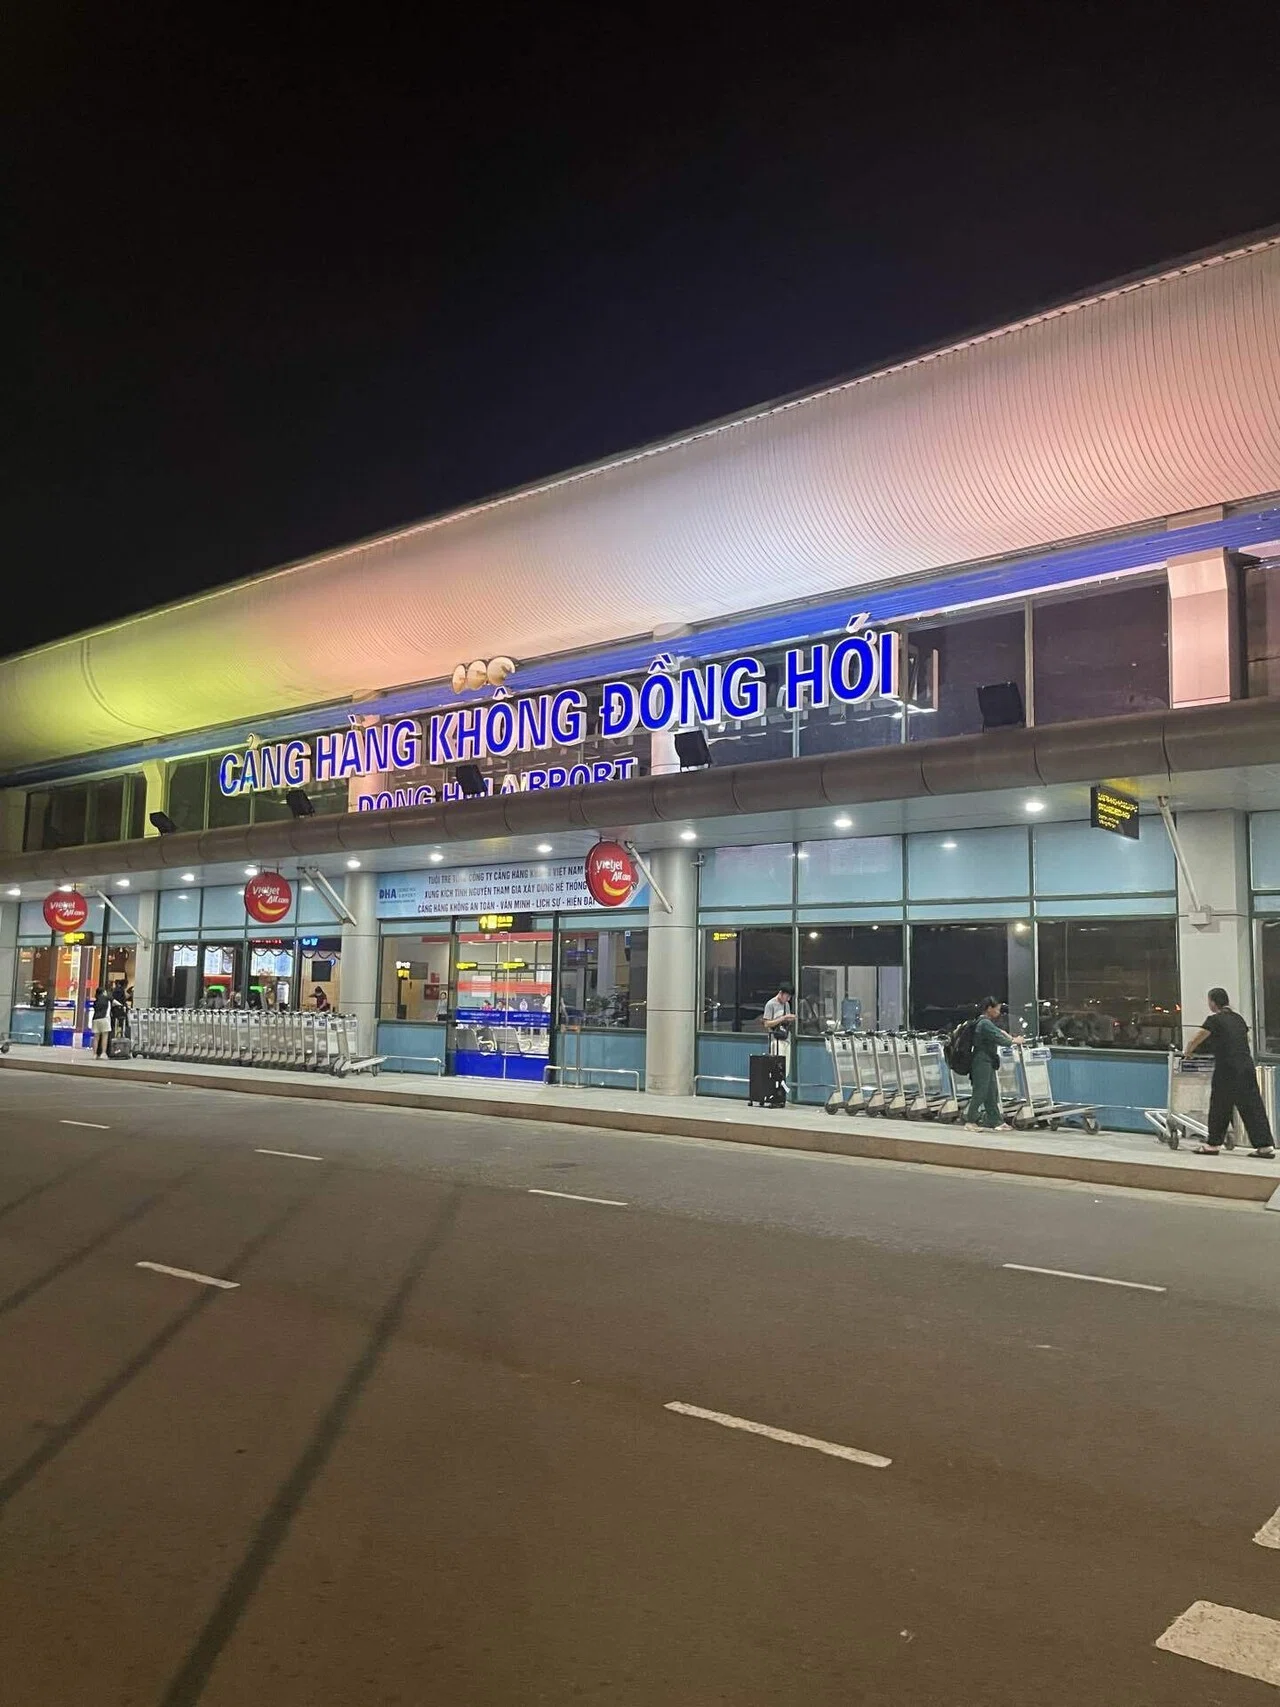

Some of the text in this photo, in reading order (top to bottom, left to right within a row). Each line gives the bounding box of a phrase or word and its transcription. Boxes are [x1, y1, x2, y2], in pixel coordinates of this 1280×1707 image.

[219, 613, 896, 797] CẢNG HÀNG KHÔNG ĐỒNG HỚI
[358, 785, 434, 812] DONG
[568, 866, 584, 875] NAM
[379, 888, 397, 899] DHA
[493, 886, 510, 895] THAM
[511, 885, 522, 894] GIA
[470, 902, 478, 911] AN
[514, 899, 530, 909] MINH
